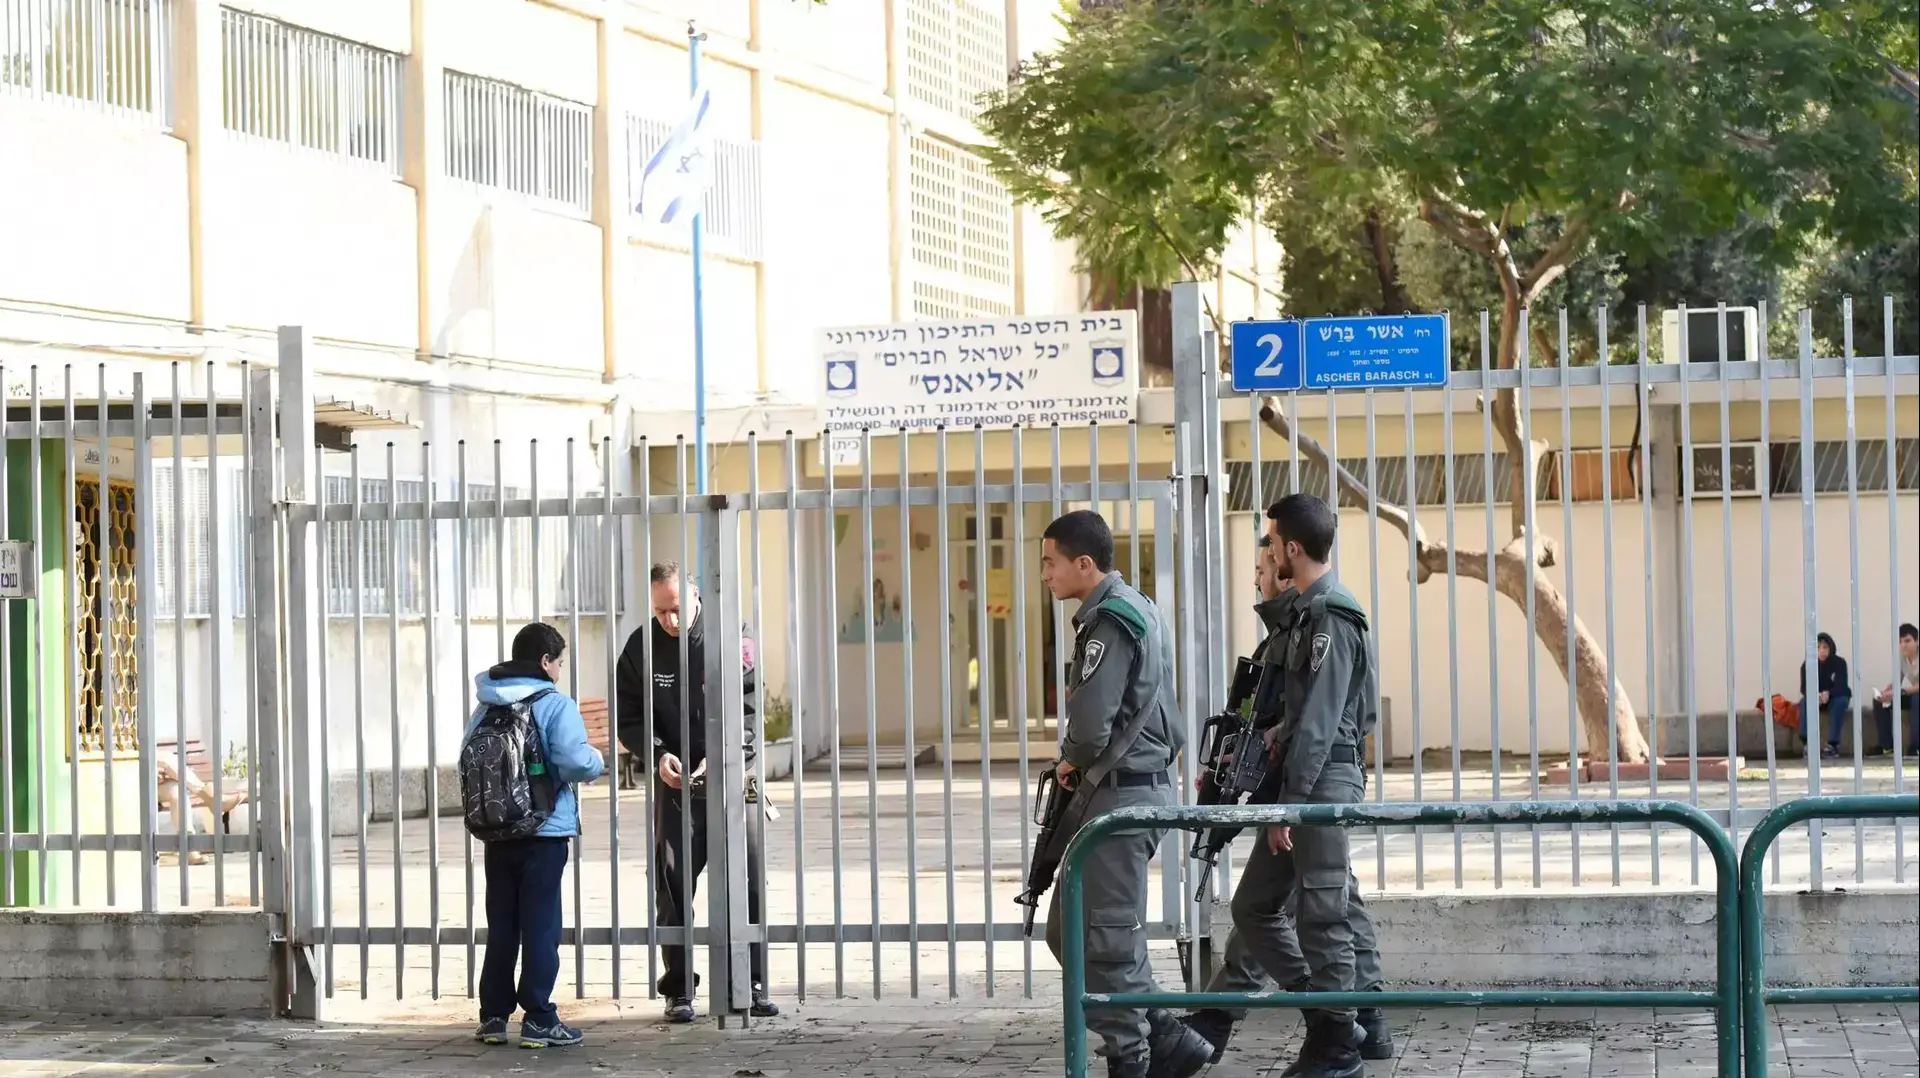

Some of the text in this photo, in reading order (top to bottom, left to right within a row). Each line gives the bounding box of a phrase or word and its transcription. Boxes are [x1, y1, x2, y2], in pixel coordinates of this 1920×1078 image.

[827, 317, 1122, 344] בית הספר התיכון העירוני
[1366, 325, 1404, 339] אשר
[958, 344, 1022, 362] ישראל
[1254, 333, 1283, 376] 2
[1316, 371, 1361, 382] ASCHER
[1365, 370, 1420, 381] BARASCH
[826, 406, 896, 418] רוטשילד
[904, 404, 926, 415] דה
[955, 414, 1013, 426] EDMOND
[1017, 413, 1036, 423] DE
[1040, 410, 1129, 422] ROTHSCHILD
